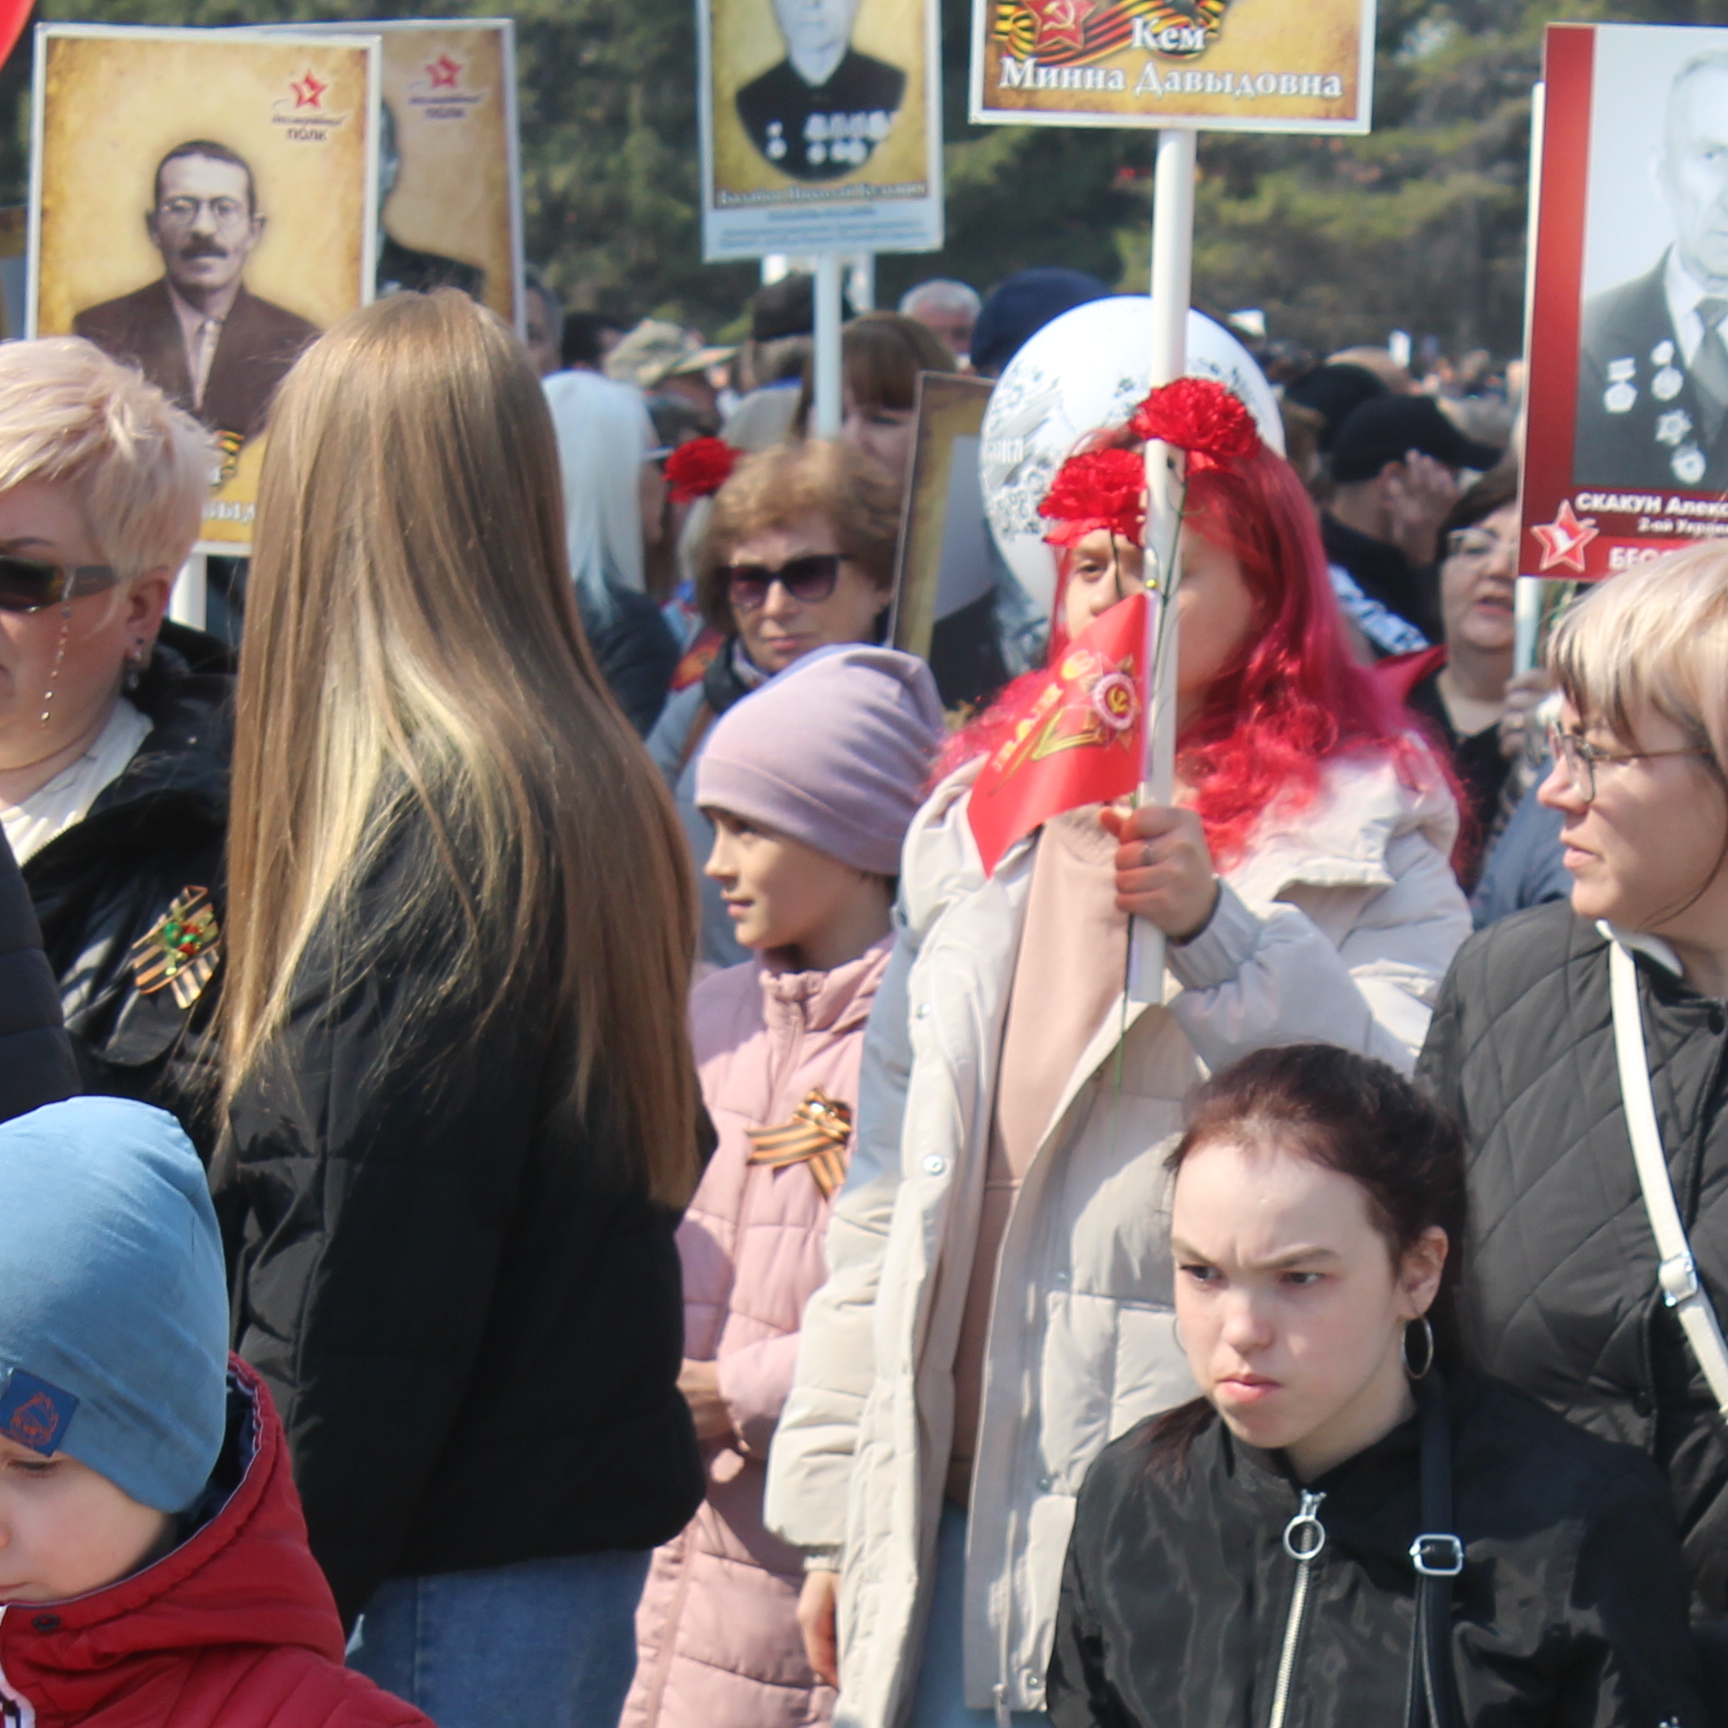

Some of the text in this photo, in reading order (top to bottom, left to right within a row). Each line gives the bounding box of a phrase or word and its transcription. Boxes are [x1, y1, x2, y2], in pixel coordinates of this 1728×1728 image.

[1129, 15, 1207, 51] Кем
[998, 55, 1344, 98] Минна Давыдовна
[1575, 492, 1663, 515] СКАКУН
